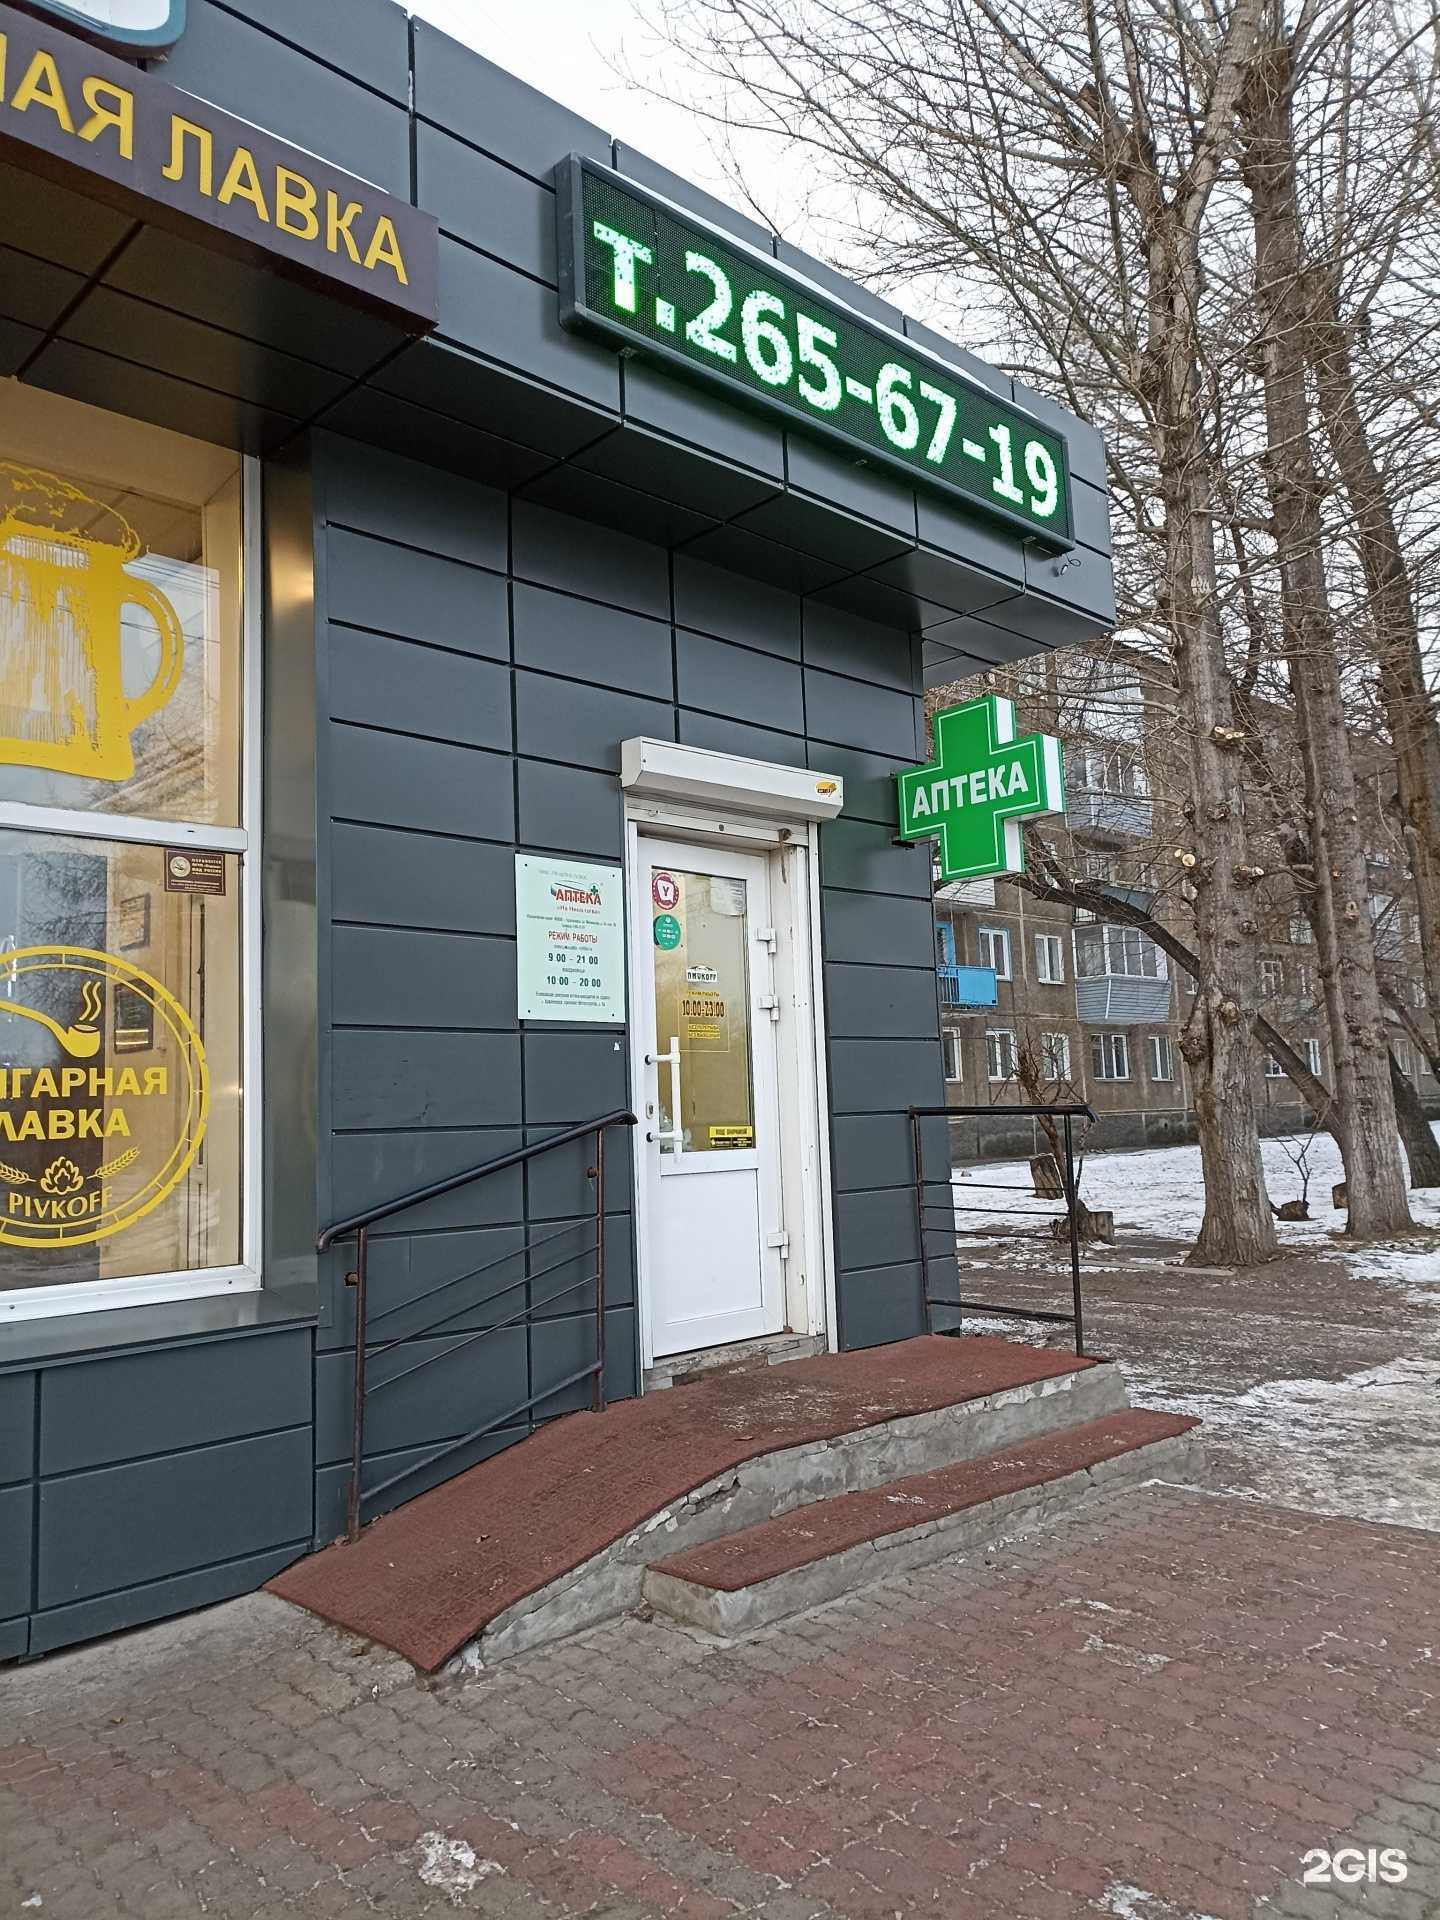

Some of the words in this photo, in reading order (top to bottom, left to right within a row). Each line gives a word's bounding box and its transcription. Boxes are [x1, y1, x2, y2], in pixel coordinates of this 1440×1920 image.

[0, 32, 134, 161] АЯ
[161, 113, 409, 286] ЛАВКА
[912, 761, 1029, 819] АПТЕКА
[555, 888, 602, 906] АПТЕКА
[548, 931, 570, 941] РЕЖИМ
[572, 933, 598, 943] РАБОТЫ
[8, 1185, 113, 1220] PIVKOFF
